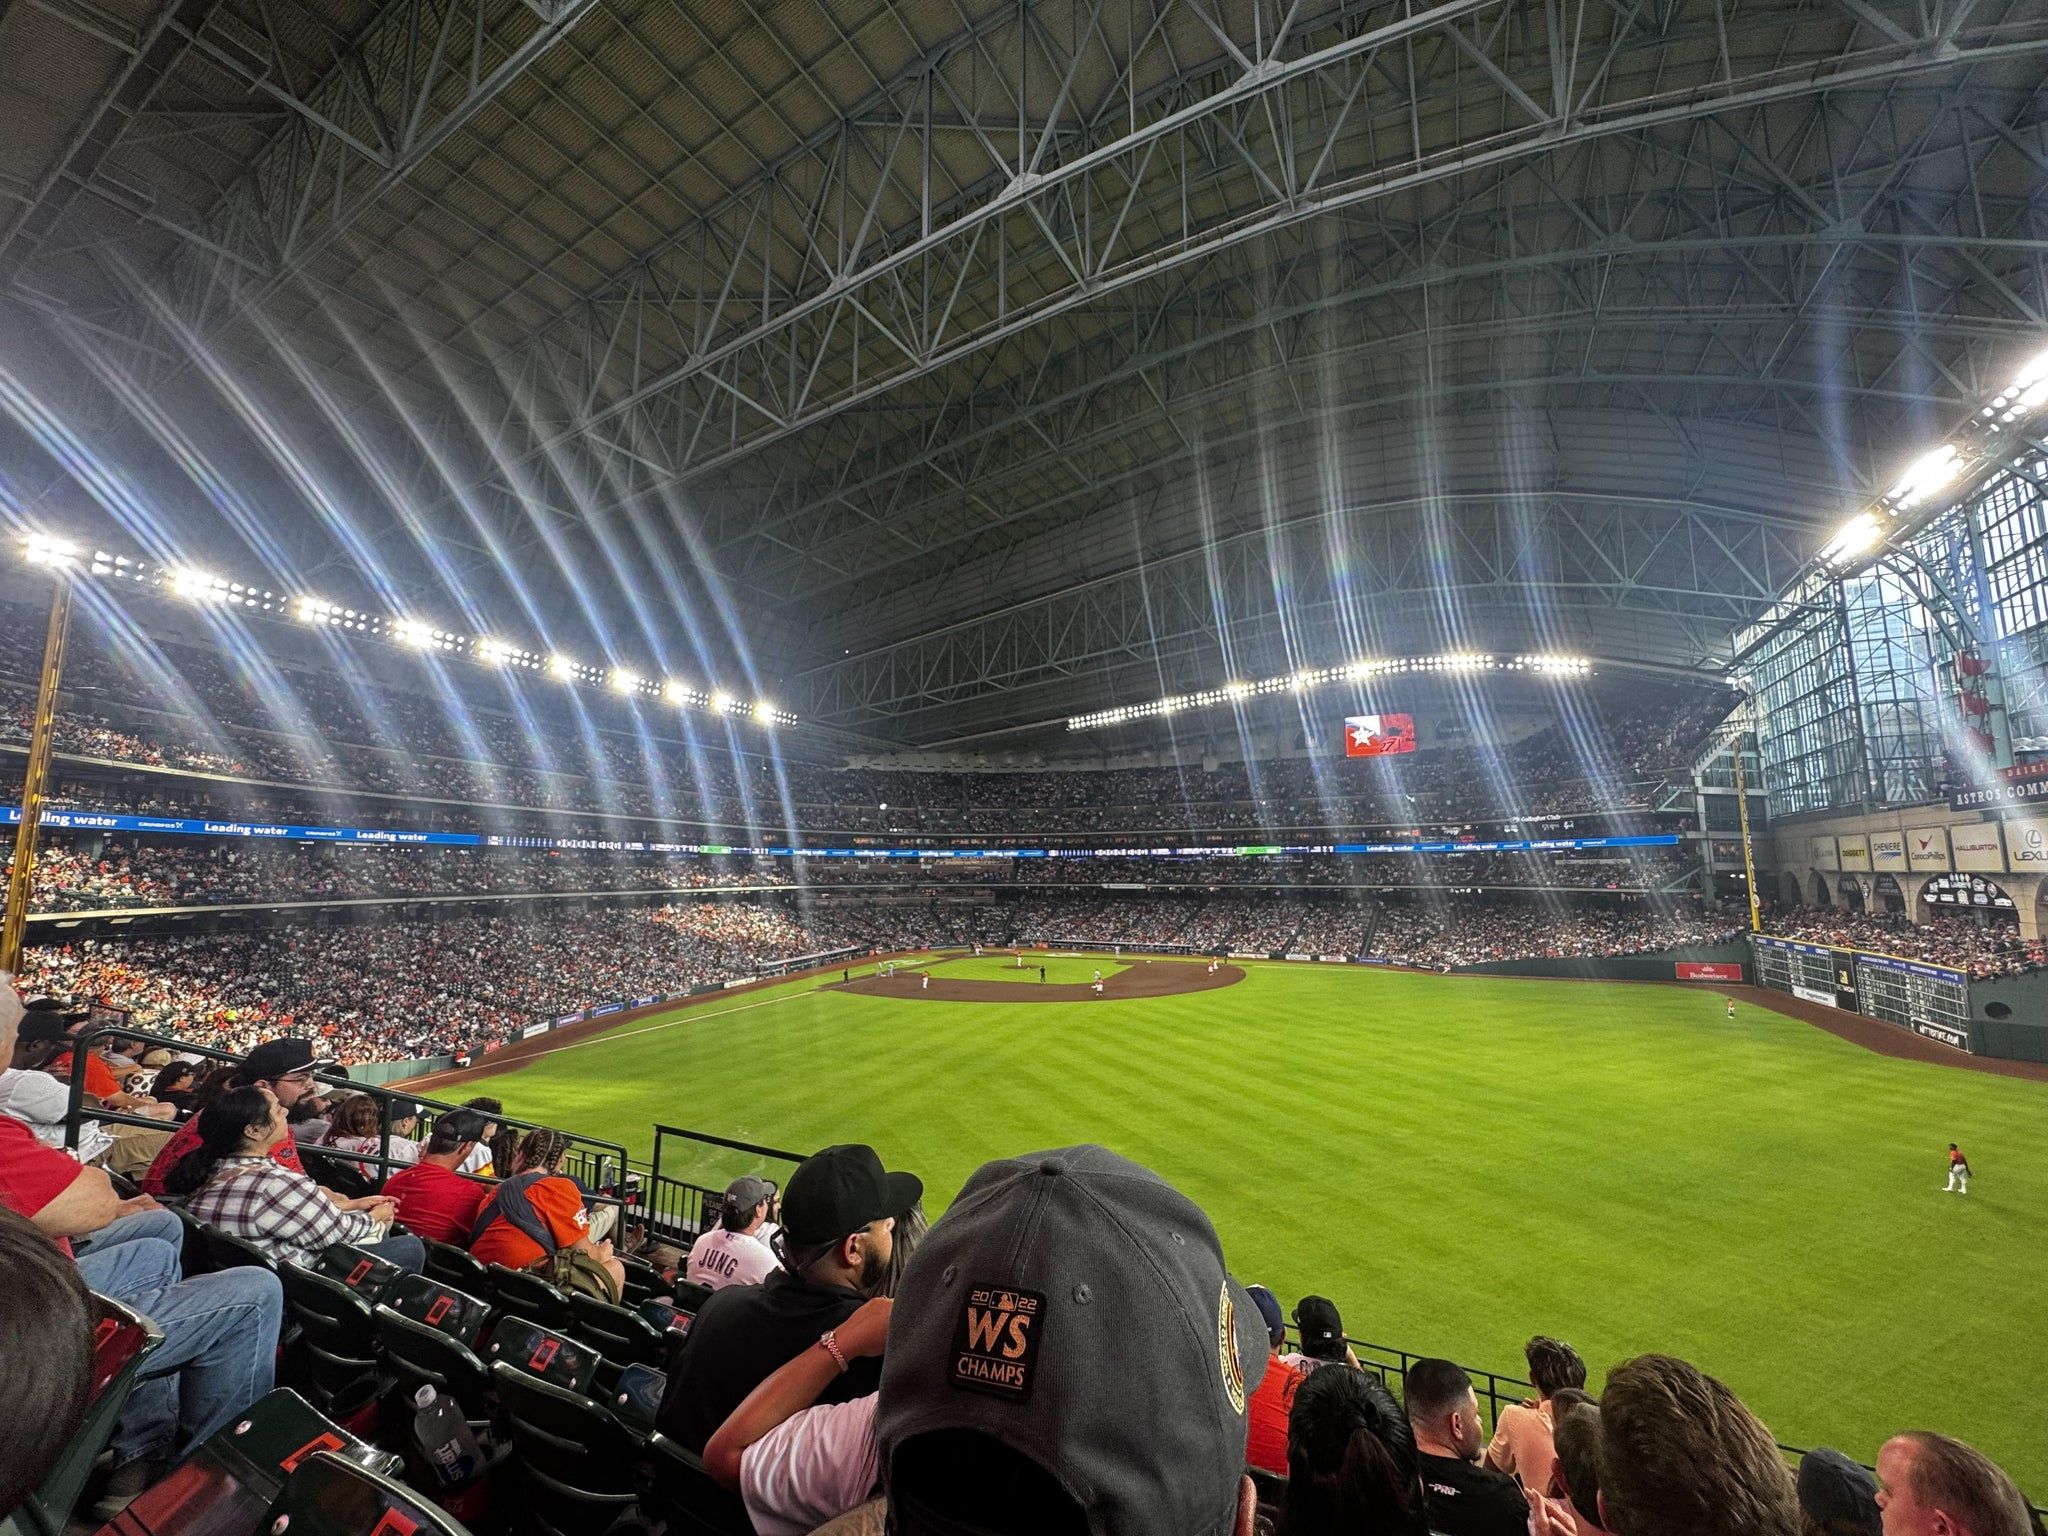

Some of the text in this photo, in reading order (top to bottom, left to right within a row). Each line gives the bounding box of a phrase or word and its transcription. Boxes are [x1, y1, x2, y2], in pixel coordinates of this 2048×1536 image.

[2008, 763, 2048, 776] DAIKI
[1957, 788, 2001, 805] ASTROS
[74, 816, 118, 826] water
[204, 823, 288, 836] Leading water
[357, 831, 397, 842] Leading
[1842, 849, 1865, 857] DOGGETT
[1873, 842, 1901, 851] CHENIERE
[1955, 844, 1998, 852] HALLIBURTON
[1911, 851, 1946, 861] ConocoPhillips
[698, 1248, 739, 1279] JUNG
[971, 1290, 1037, 1310] 20 22
[968, 1307, 1030, 1358] WS
[958, 1357, 1025, 1386] CHAMPS
[434, 1443, 464, 1481] smart
